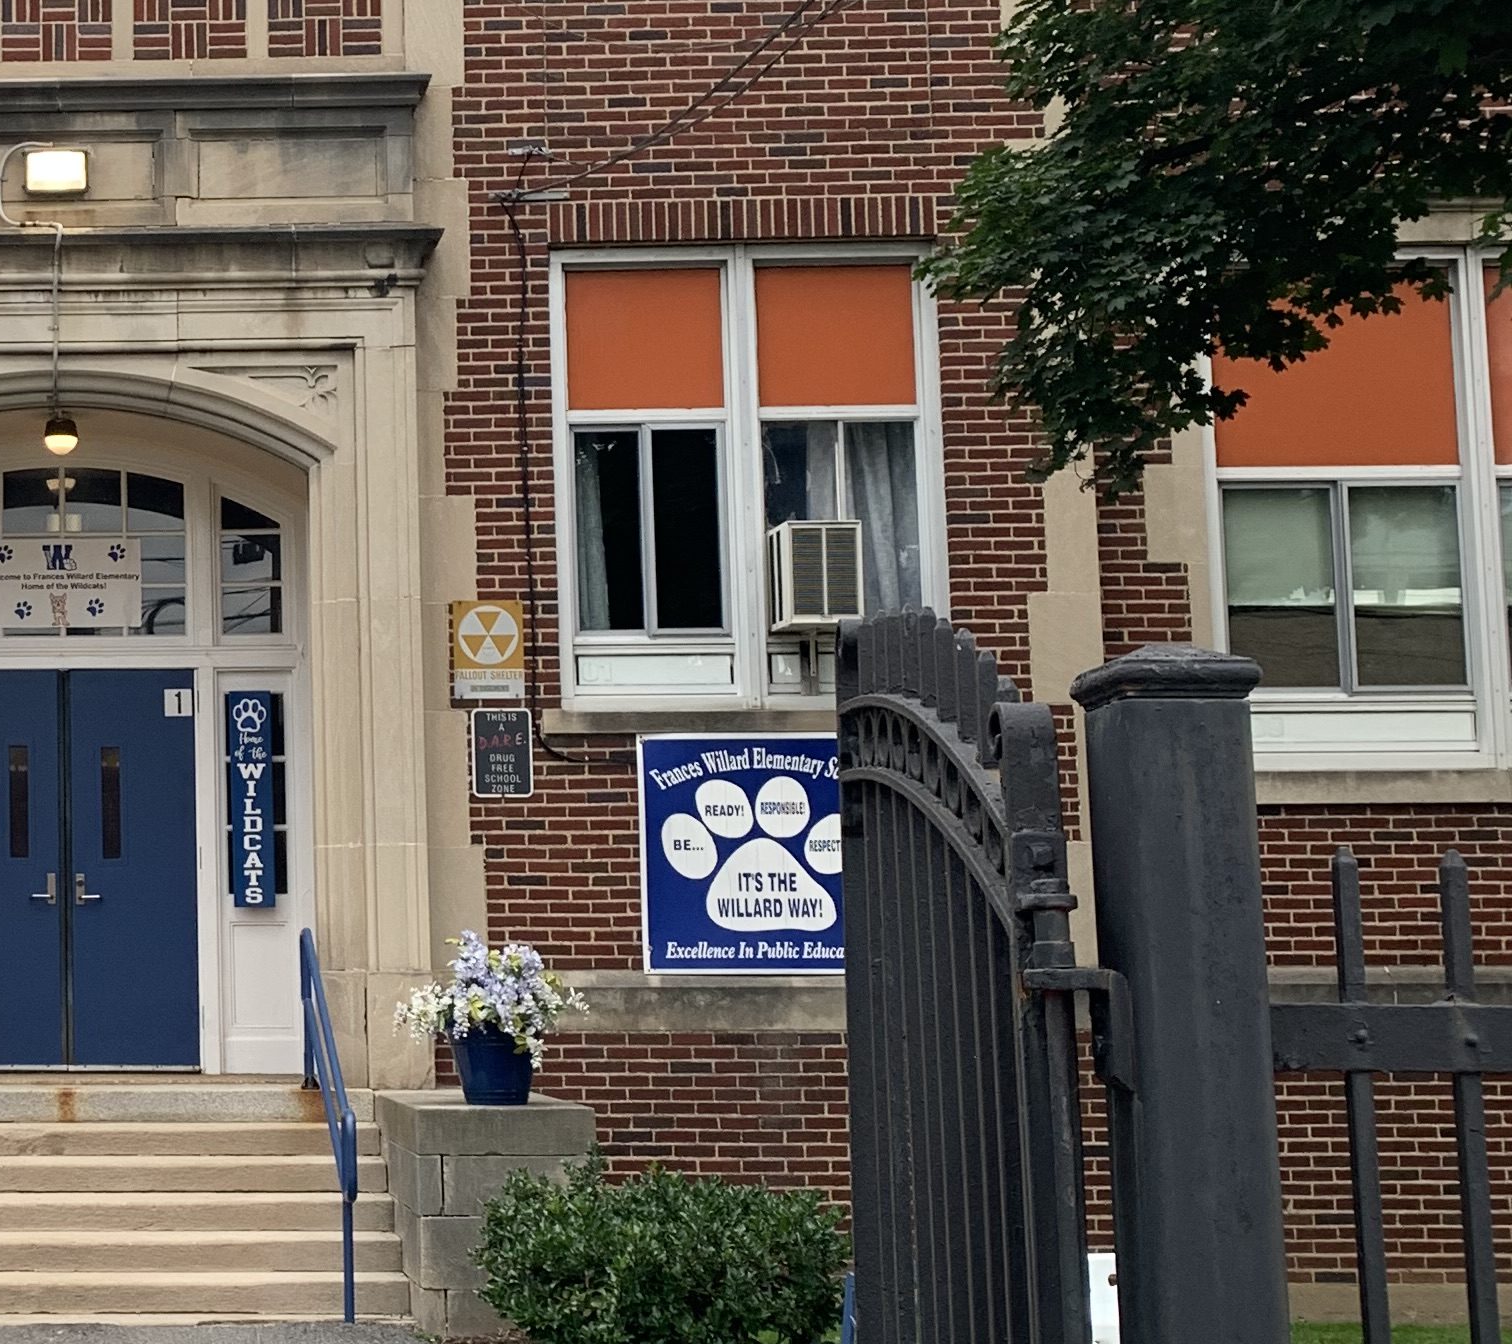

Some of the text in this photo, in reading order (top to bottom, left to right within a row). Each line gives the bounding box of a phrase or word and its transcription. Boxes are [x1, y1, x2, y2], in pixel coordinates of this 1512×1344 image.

[96, 572, 140, 581] Elementary
[21, 582, 44, 590] Home
[454, 670, 523, 680] FALLOUT SHELTER
[174, 691, 182, 714] 1
[486, 713, 517, 722] THIS IS
[498, 723, 505, 731] A
[239, 732, 264, 745] Home
[234, 746, 267, 760] of the
[489, 754, 515, 762] DRUG
[491, 764, 514, 773] FREE
[649, 762, 704, 790] Frances
[700, 748, 750, 774] Willard
[752, 747, 825, 780] Elementary
[484, 774, 522, 783] SCHOOL
[491, 784, 515, 793] ZONE
[704, 805, 745, 817] READY!
[760, 802, 806, 815] RESPONSIBLE!
[237, 763, 266, 904] WILDCATS
[673, 839, 704, 851] BE...
[738, 872, 797, 892] IT'S THE
[717, 898, 823, 918] WILLARD WAY!
[665, 941, 736, 959] Excellence
[738, 941, 754, 959] In
[756, 941, 800, 959] Public
